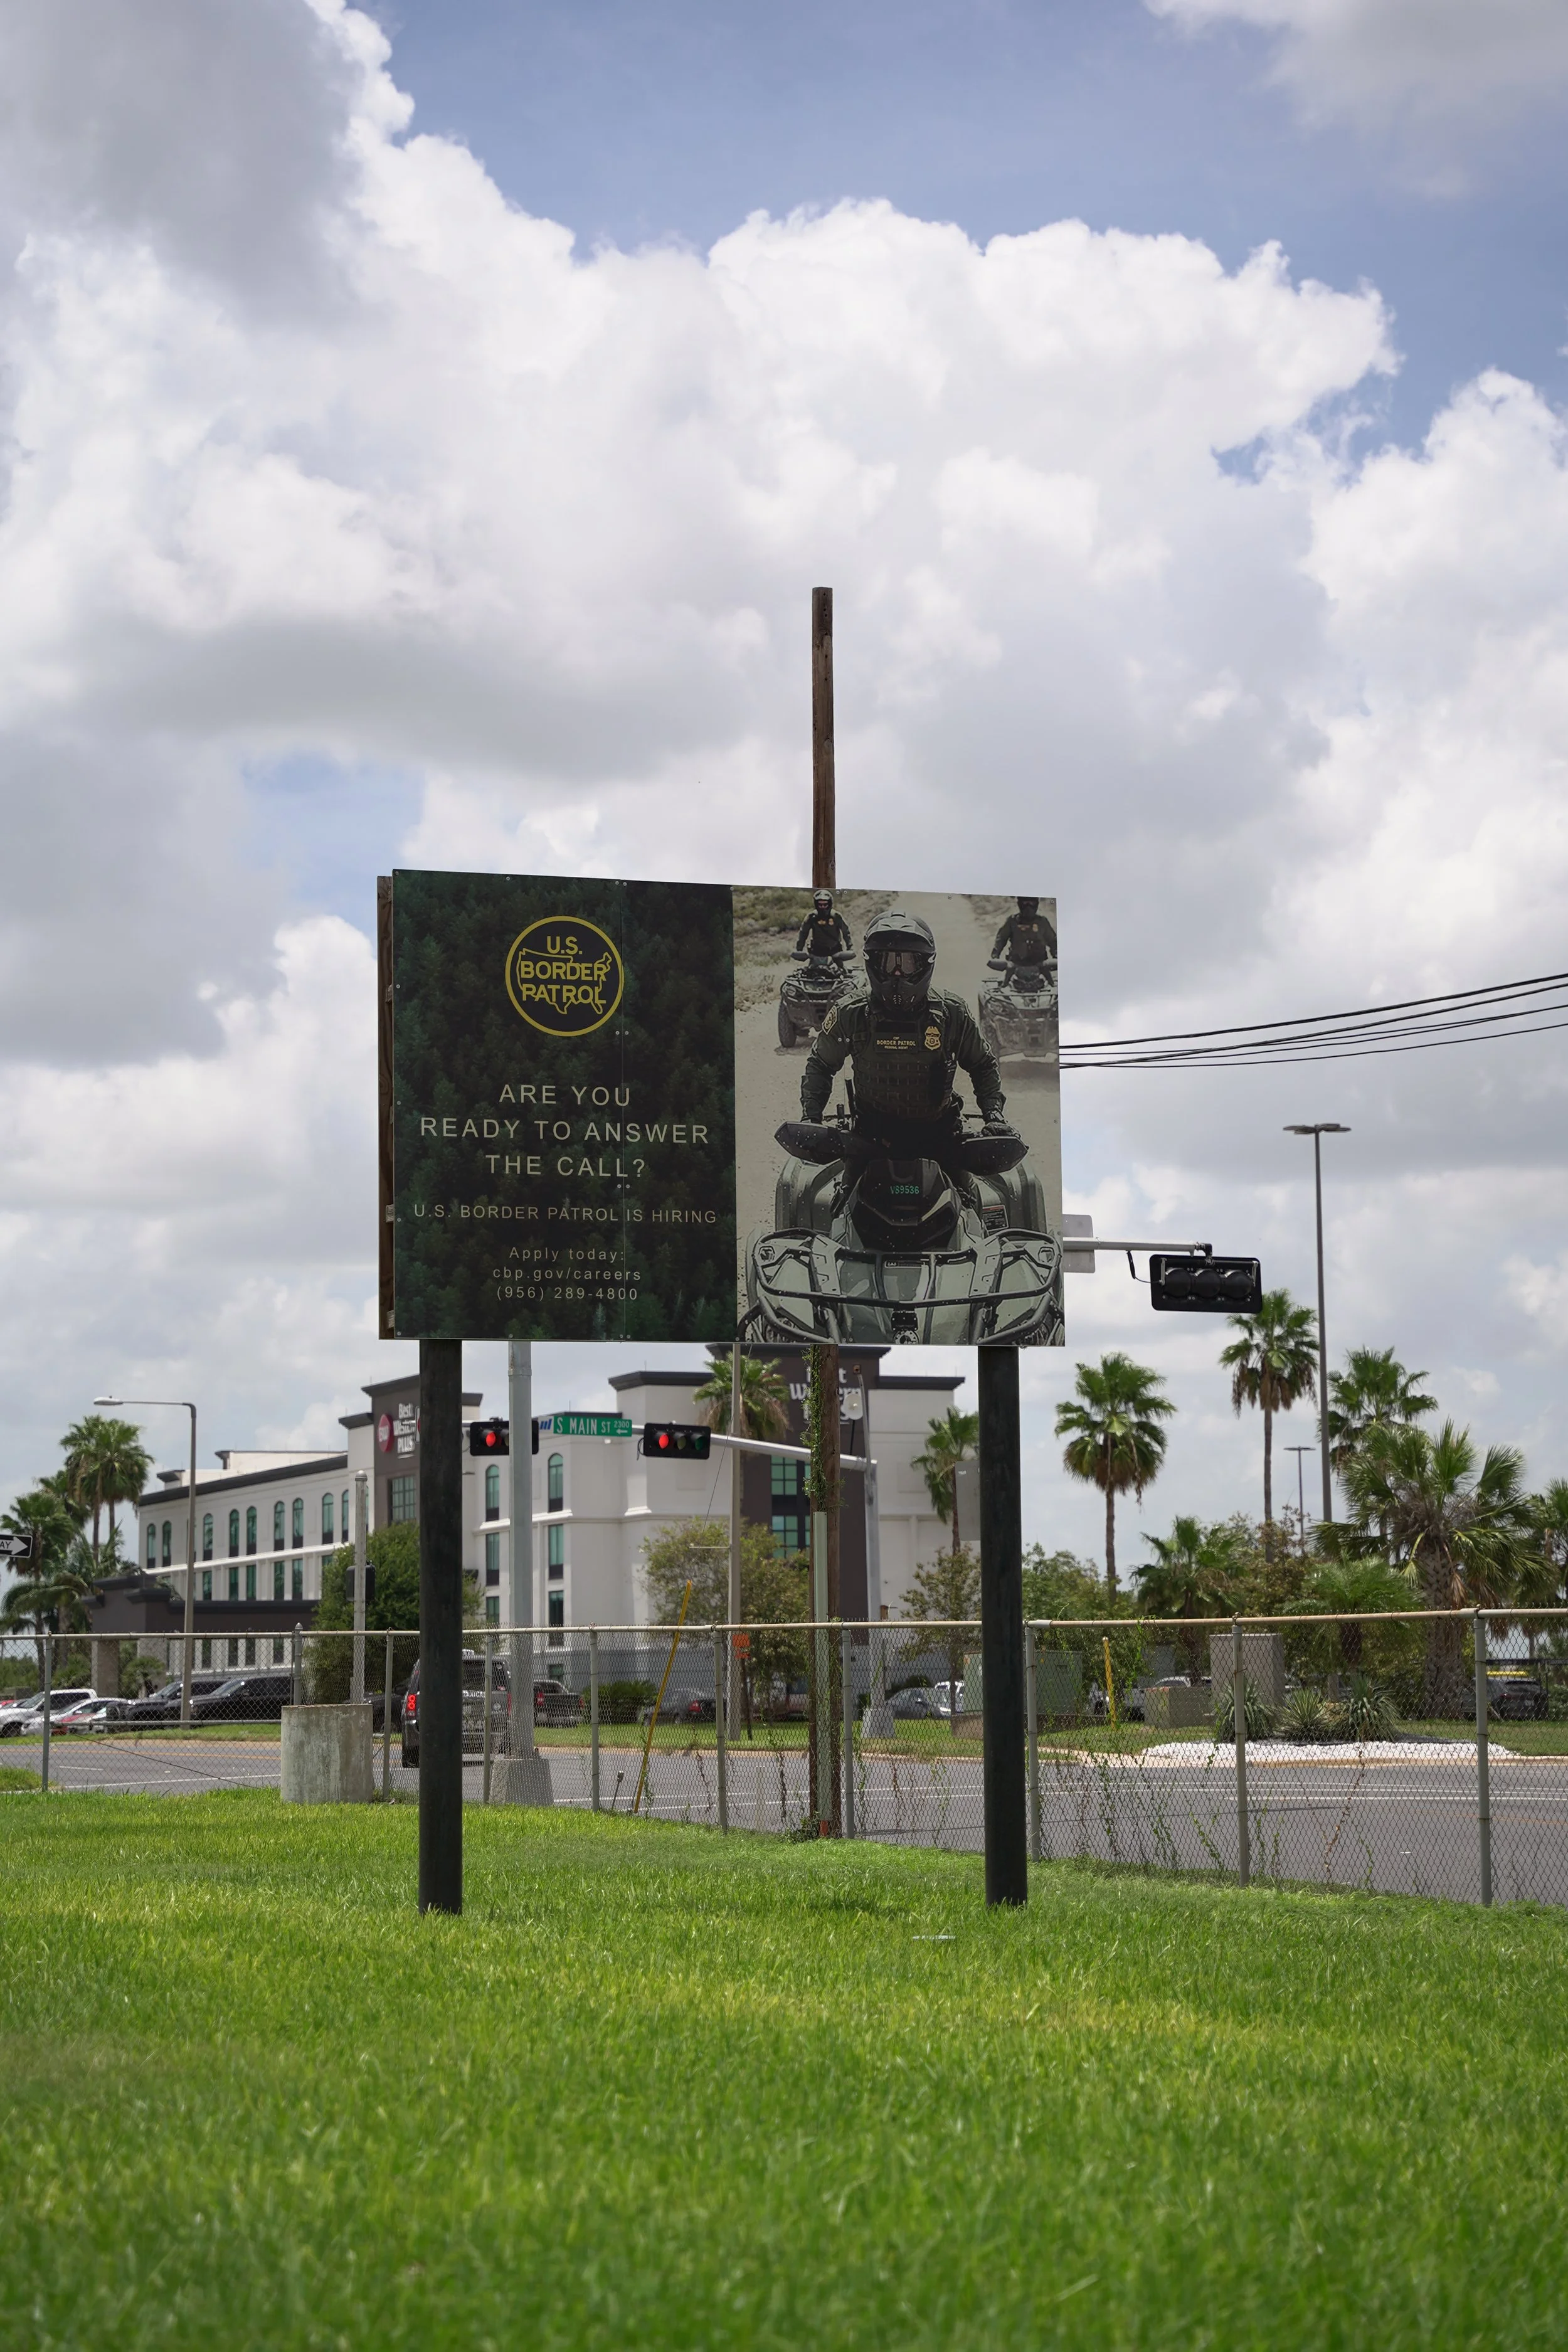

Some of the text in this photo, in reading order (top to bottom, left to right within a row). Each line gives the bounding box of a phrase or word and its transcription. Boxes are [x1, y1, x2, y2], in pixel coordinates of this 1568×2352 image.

[546, 935, 583, 955] U.S.
[521, 961, 607, 982] BORDER
[522, 983, 607, 1004] PATROL
[499, 1084, 630, 1107] ARE YOU
[421, 1117, 709, 1144] READY TO ANSWER
[485, 1155, 645, 1179] THE CALL?
[414, 1204, 716, 1224] U.S. BORDER PATROL IS HIRING
[509, 1246, 625, 1263] Apply today:
[492, 1266, 641, 1281] cbp.gov/careers
[496, 1286, 638, 1301] (956) 289-4800
[556, 1417, 563, 1433] S
[569, 1417, 597, 1434] MAIN
[601, 1421, 611, 1433] ST
[0, 1540, 11, 1549] AY
